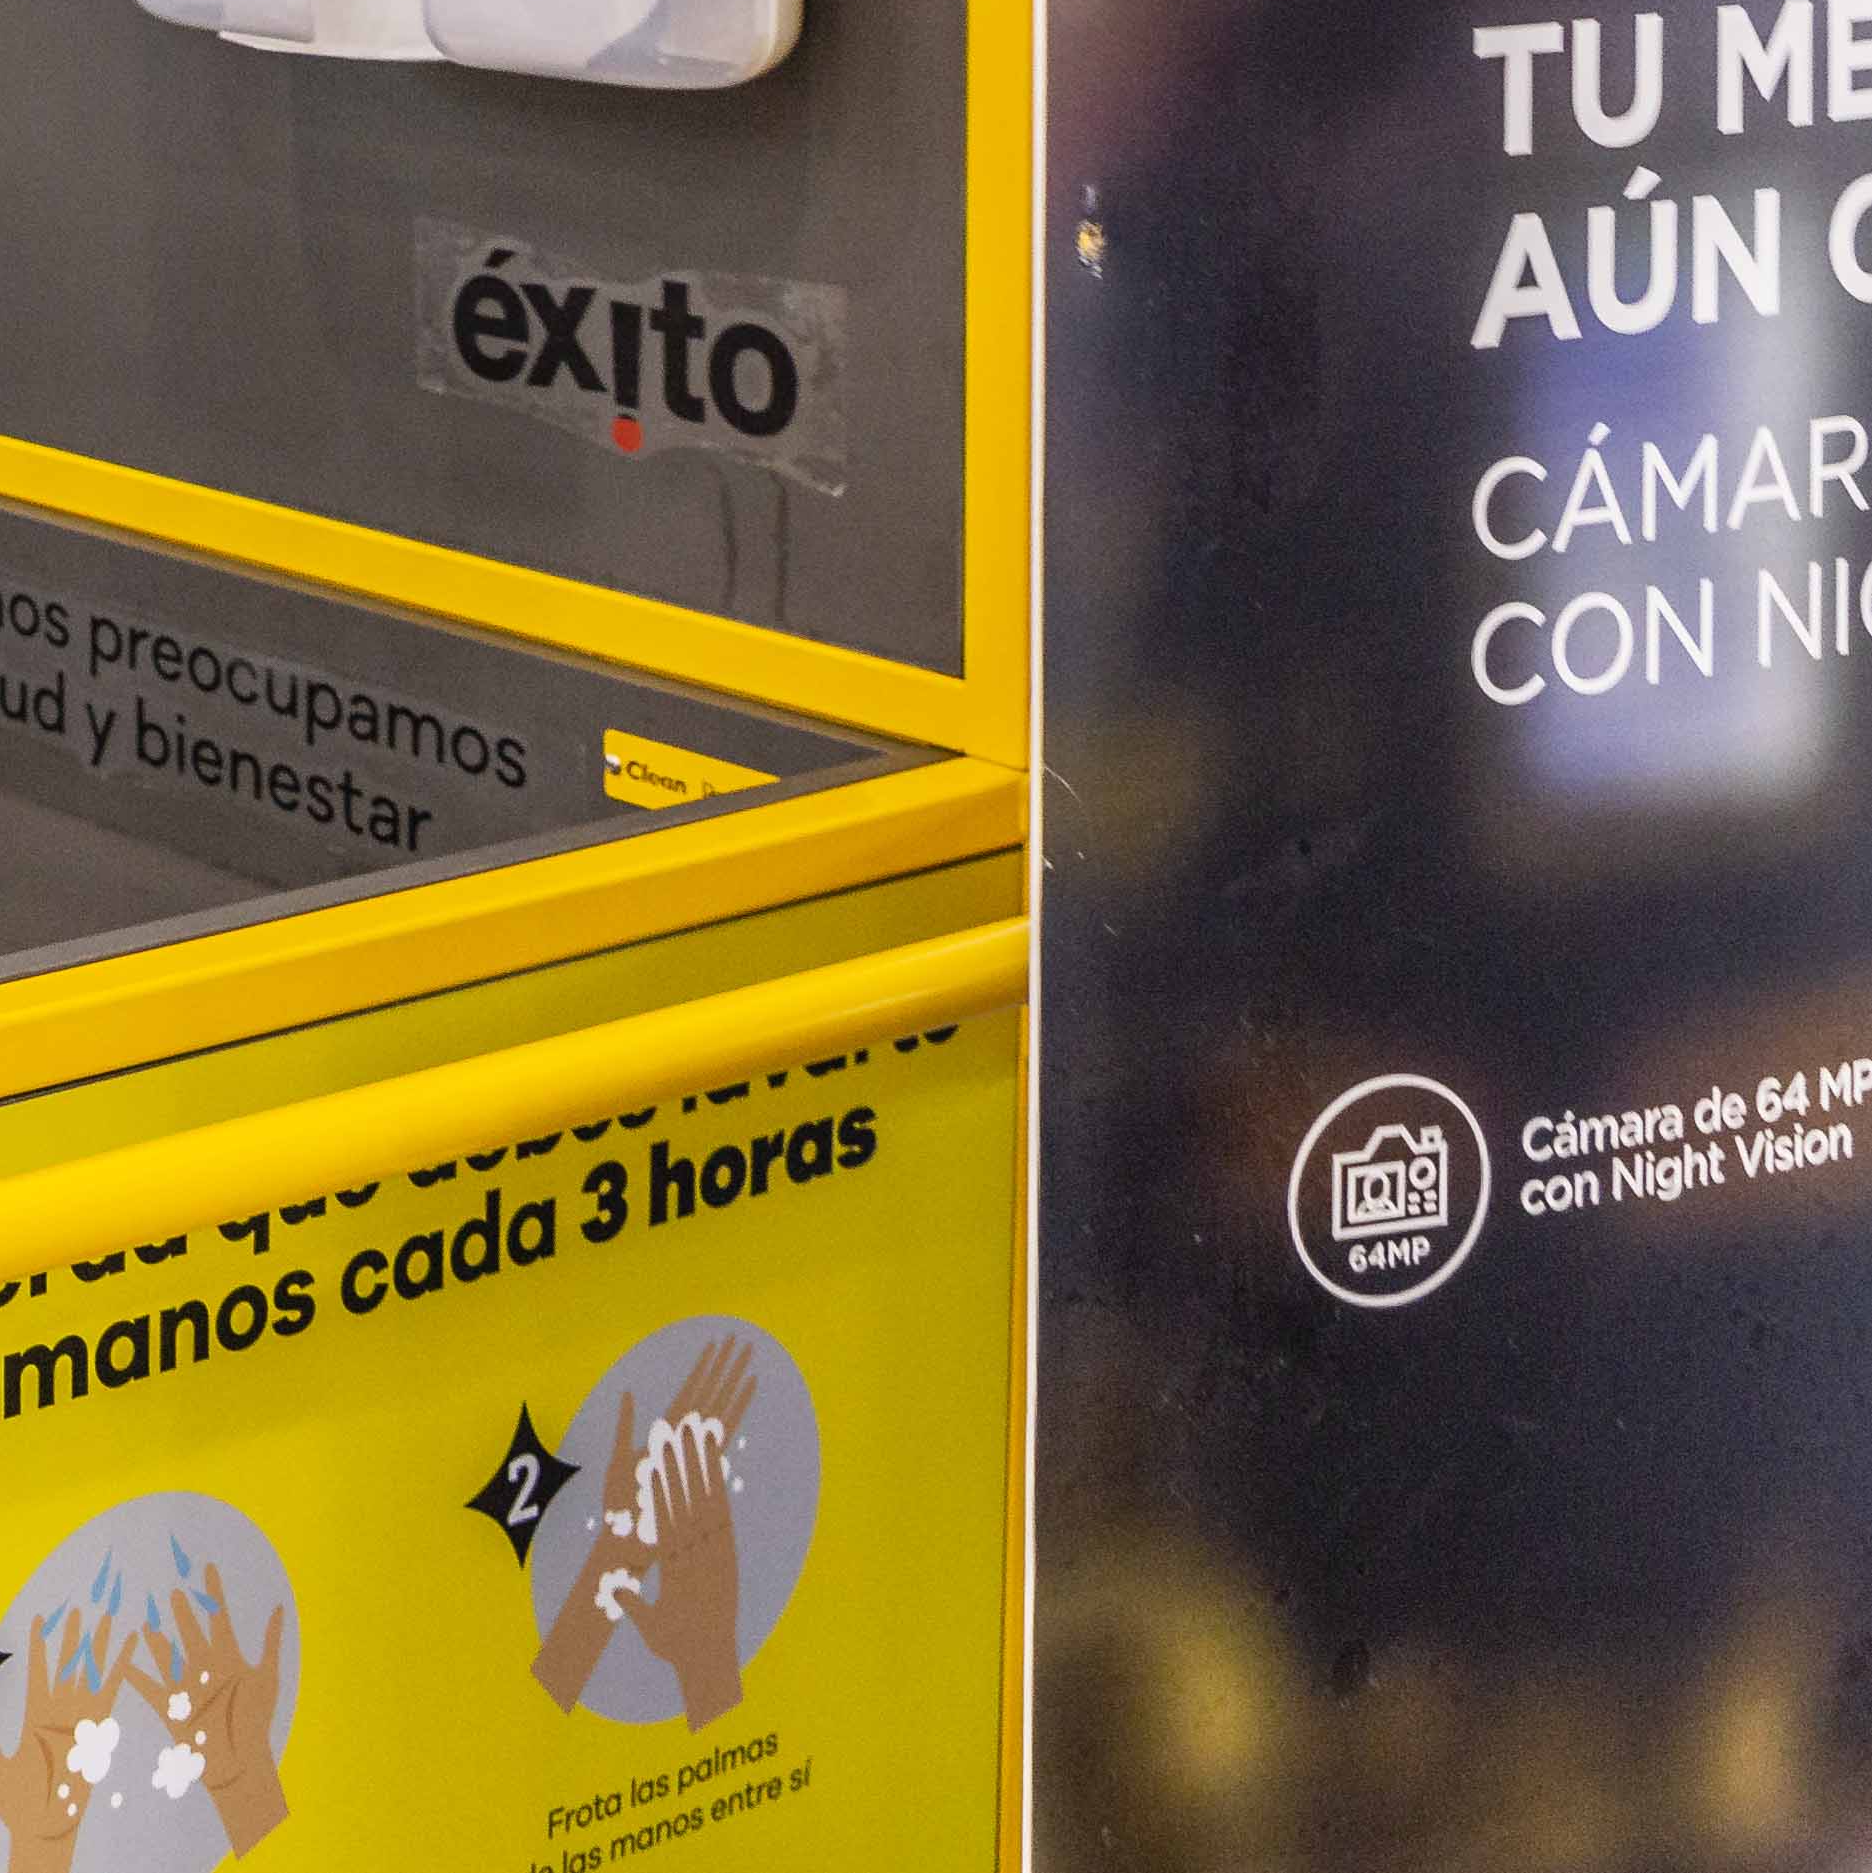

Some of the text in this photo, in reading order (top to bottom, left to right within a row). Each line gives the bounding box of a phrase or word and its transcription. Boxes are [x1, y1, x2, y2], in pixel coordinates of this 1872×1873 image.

[1471, 12, 1665, 157] TU
[1469, 164, 1782, 352] AÚN
[1470, 413, 1872, 562] CÁMAR
[87, 614, 529, 790] preocupamos
[1470, 555, 1872, 707] CON NI
[85, 700, 117, 768] y
[134, 695, 436, 854] bienestar
[1519, 1121, 1854, 1217] con Night Vision
[1521, 1057, 1872, 1164] Cámara de 64 MP
[1, 1266, 317, 1420] manos
[340, 1189, 559, 1314] cada
[580, 1160, 630, 1246] 3
[649, 1105, 879, 1228] horas
[1347, 1233, 1432, 1274] 64MP
[507, 1453, 543, 1529] 2
[547, 1732, 780, 1841] Frota las palmas
[610, 1806, 705, 1861] manos
[710, 1775, 783, 1823] entre
[789, 1755, 814, 1793] sí
